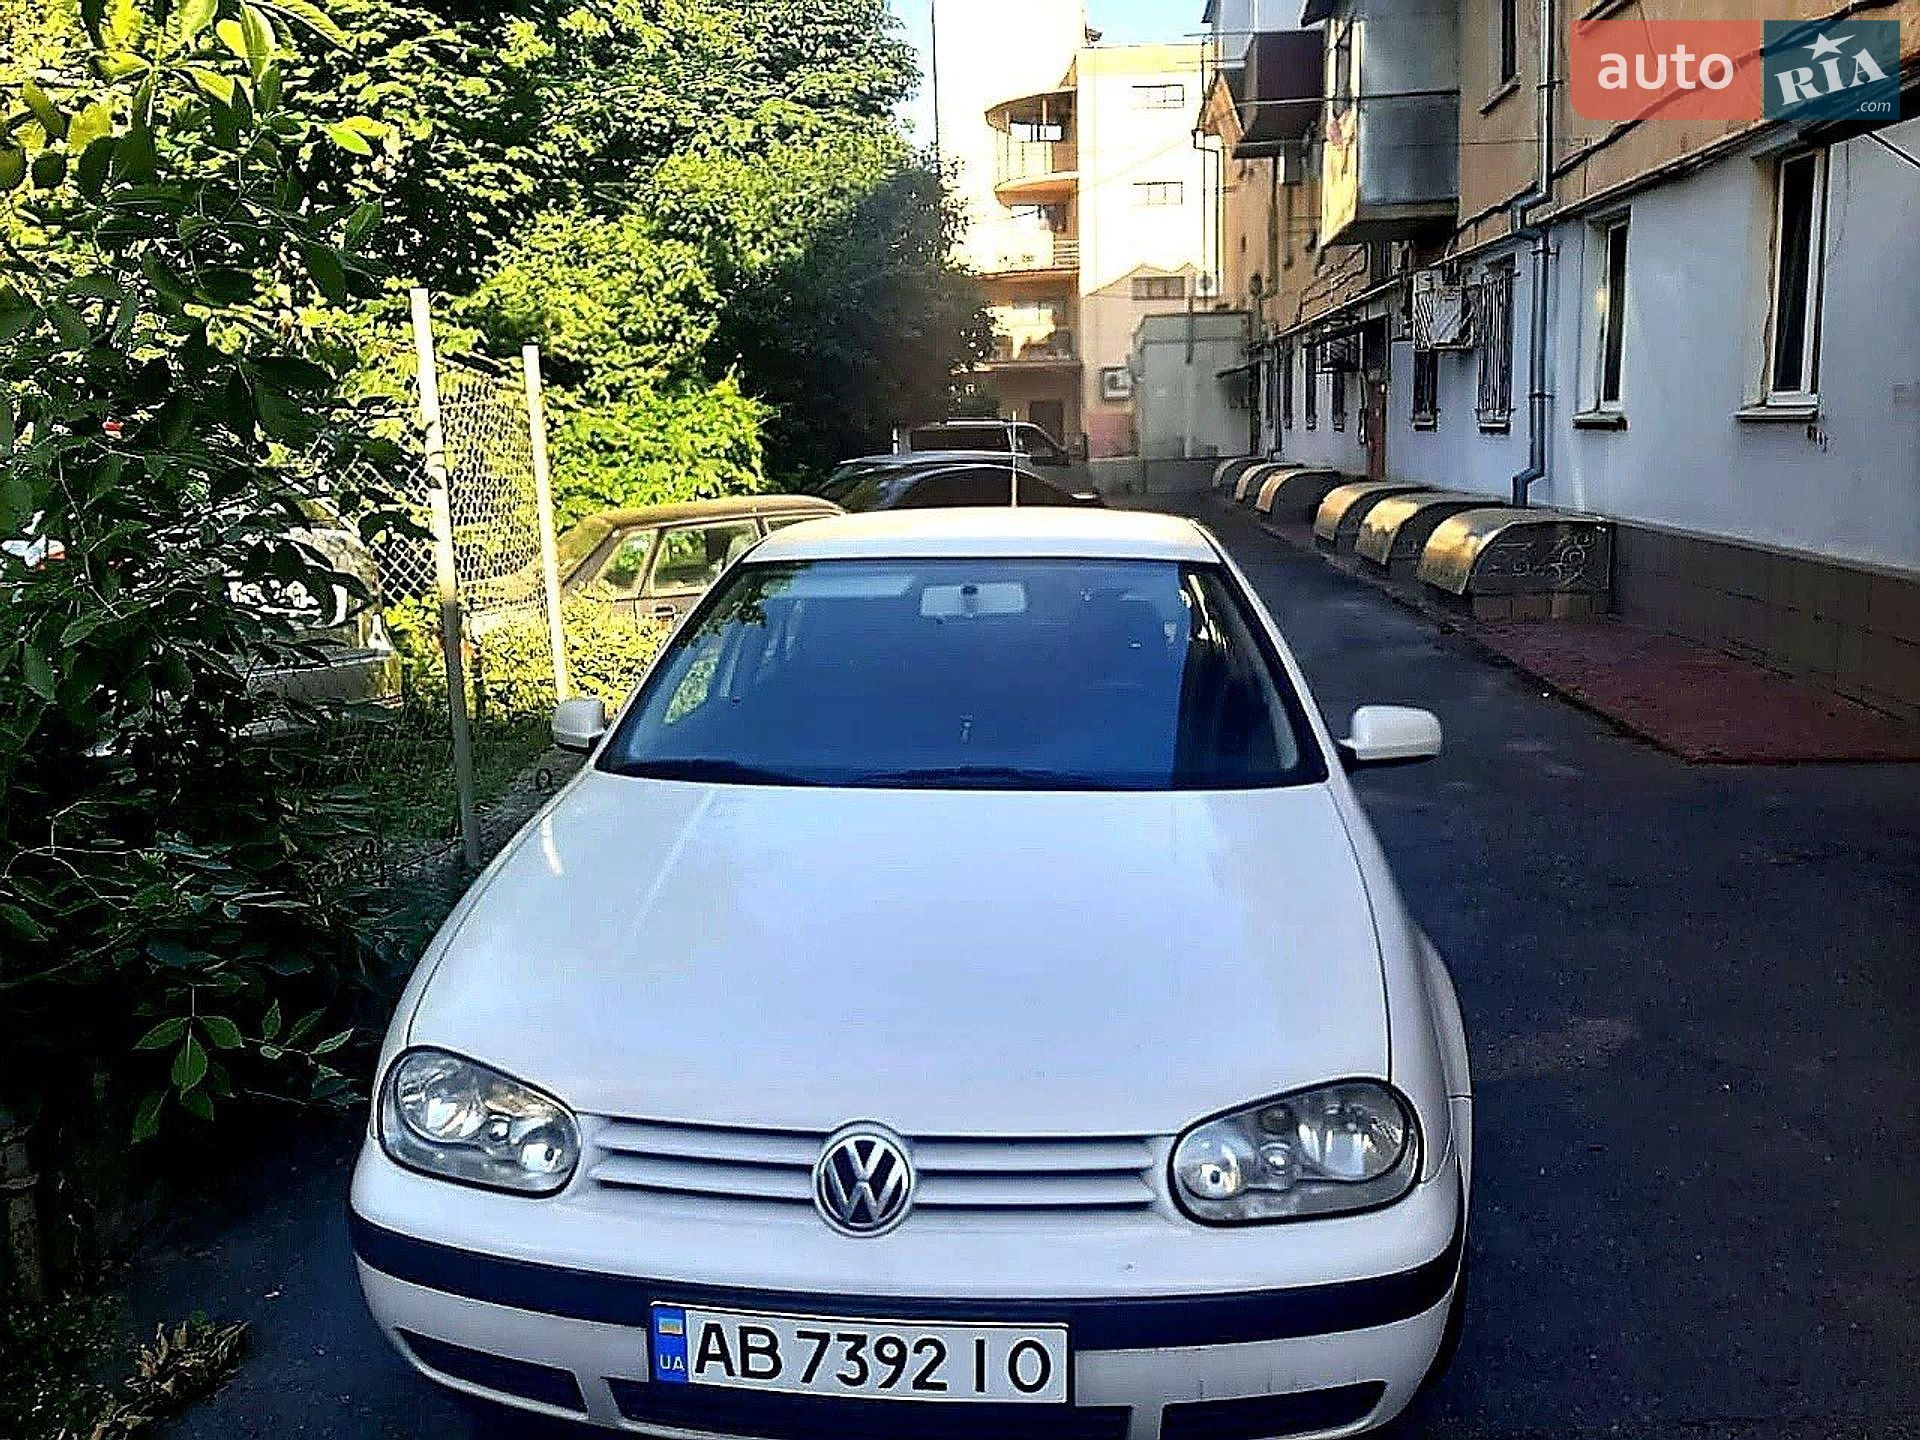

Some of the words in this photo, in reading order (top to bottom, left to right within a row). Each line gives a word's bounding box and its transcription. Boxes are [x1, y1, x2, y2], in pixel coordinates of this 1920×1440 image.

[659, 1354, 685, 1371] UA
[695, 1323, 783, 1380] AB
[796, 1330, 948, 1392] 7392
